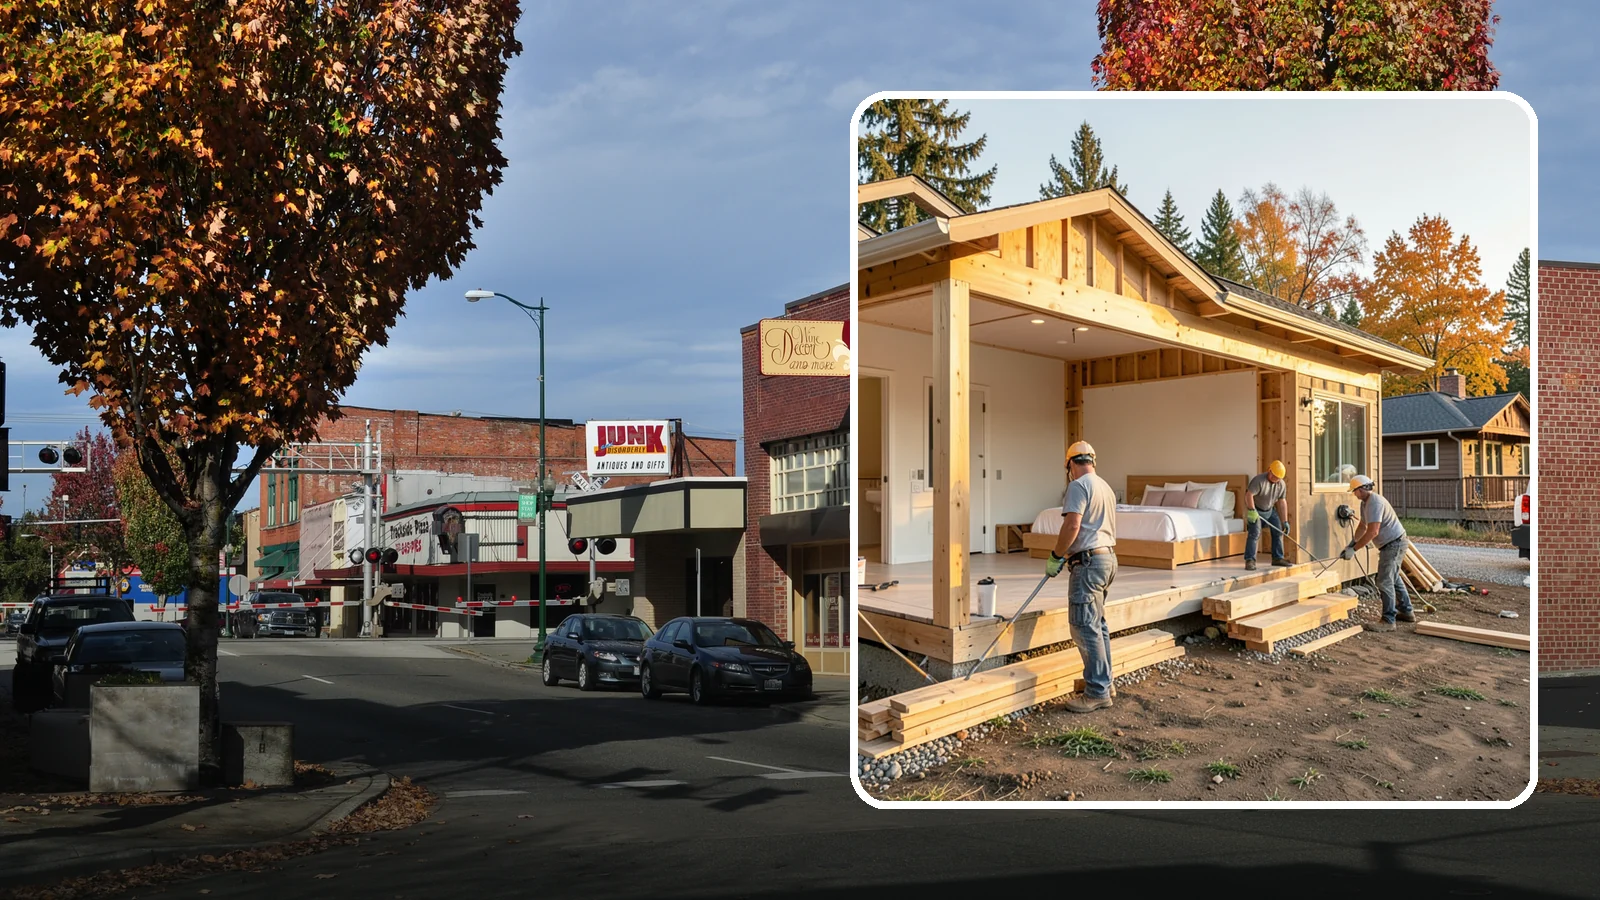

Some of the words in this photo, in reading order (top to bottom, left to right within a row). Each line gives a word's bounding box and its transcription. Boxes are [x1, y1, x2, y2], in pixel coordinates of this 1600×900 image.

[595, 425, 664, 457] JUNK
[596, 461, 628, 470] ANTIQUES
[631, 461, 644, 470] AND
[647, 460, 665, 469] GIFTS
[352, 498, 365, 511] CRO
[414, 519, 429, 535] Pizza
